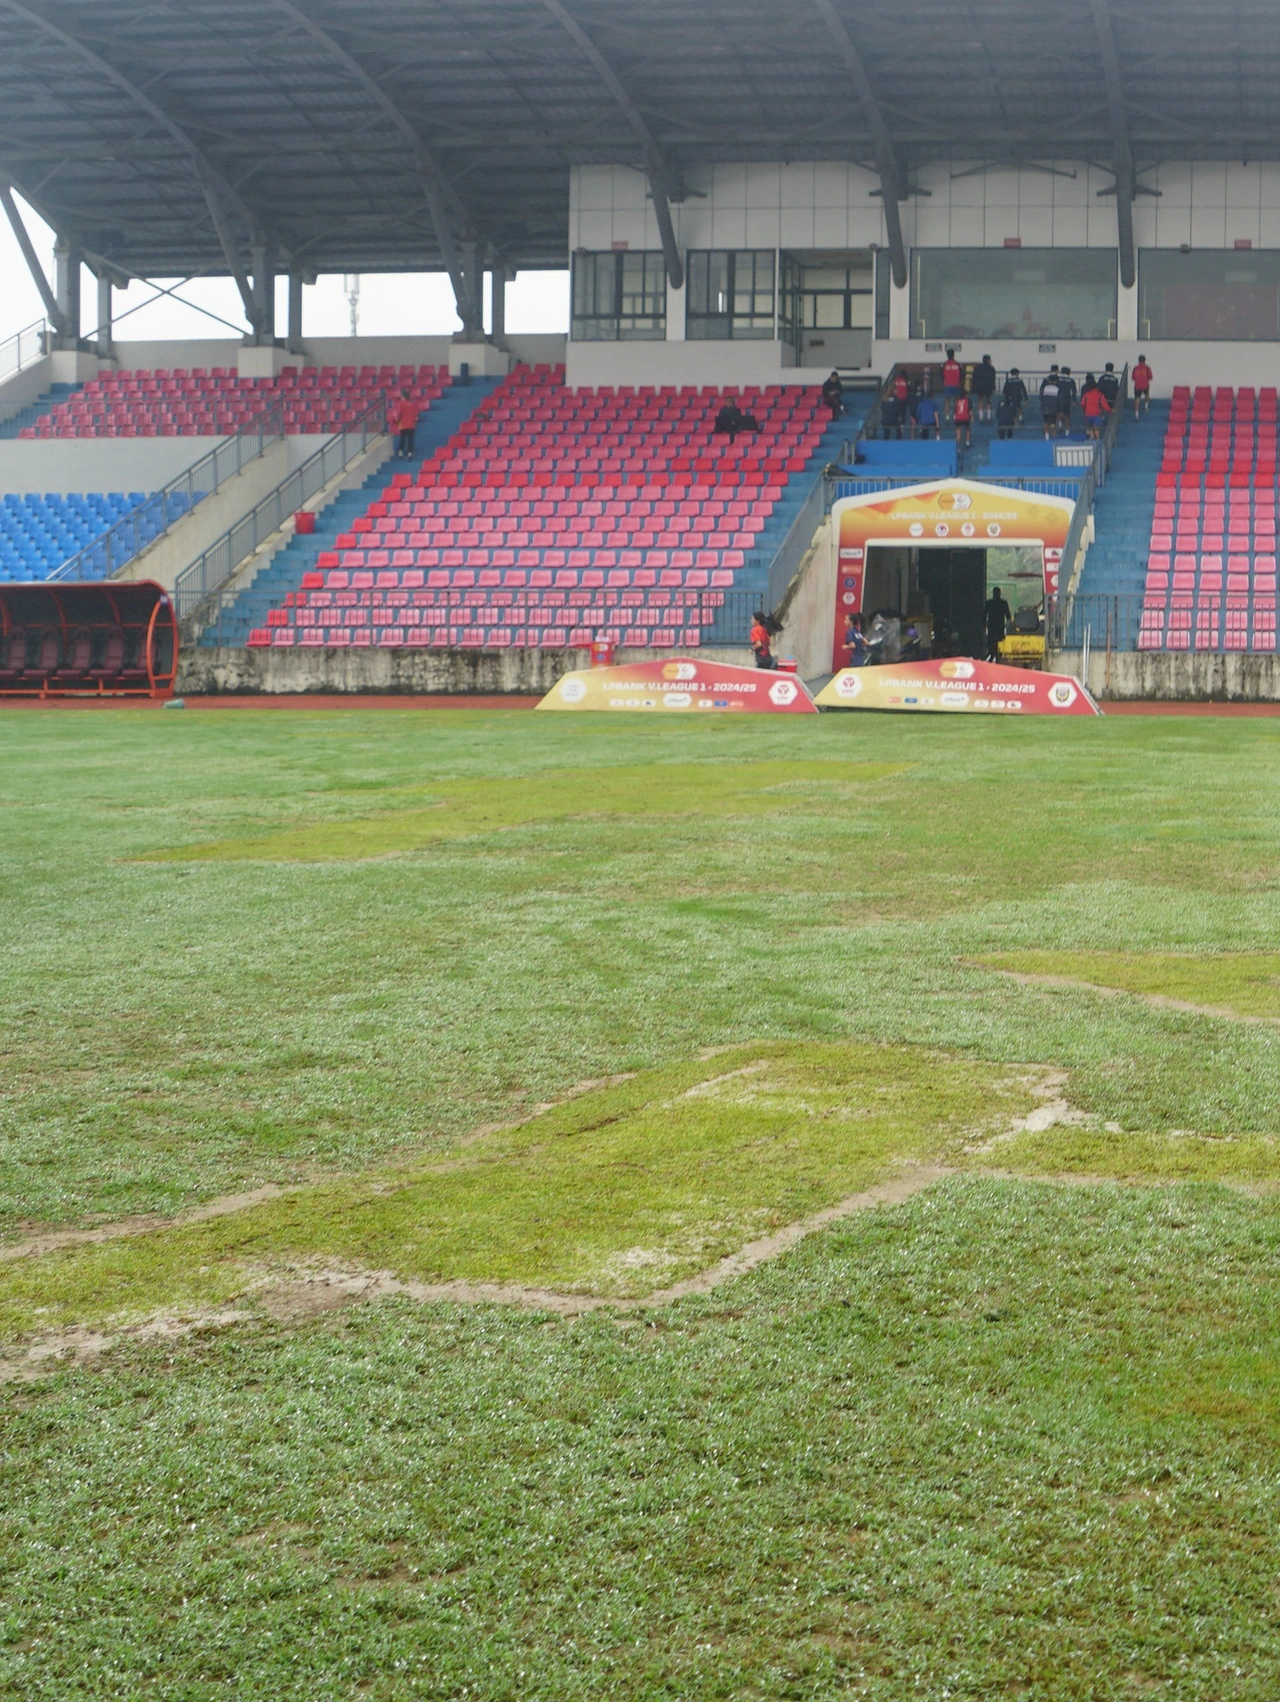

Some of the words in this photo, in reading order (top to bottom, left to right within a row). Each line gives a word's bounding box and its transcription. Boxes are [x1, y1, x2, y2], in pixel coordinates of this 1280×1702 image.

[603, 682, 645, 691] LPBANK
[648, 682, 698, 692] V.LEAGUE
[700, 683, 706, 691] 1
[713, 683, 757, 693] 2024/25
[879, 679, 923, 688] LPBANK
[925, 680, 977, 691] V.LEAGUE
[978, 682, 984, 692] 1
[991, 683, 1036, 693] 2024/25
